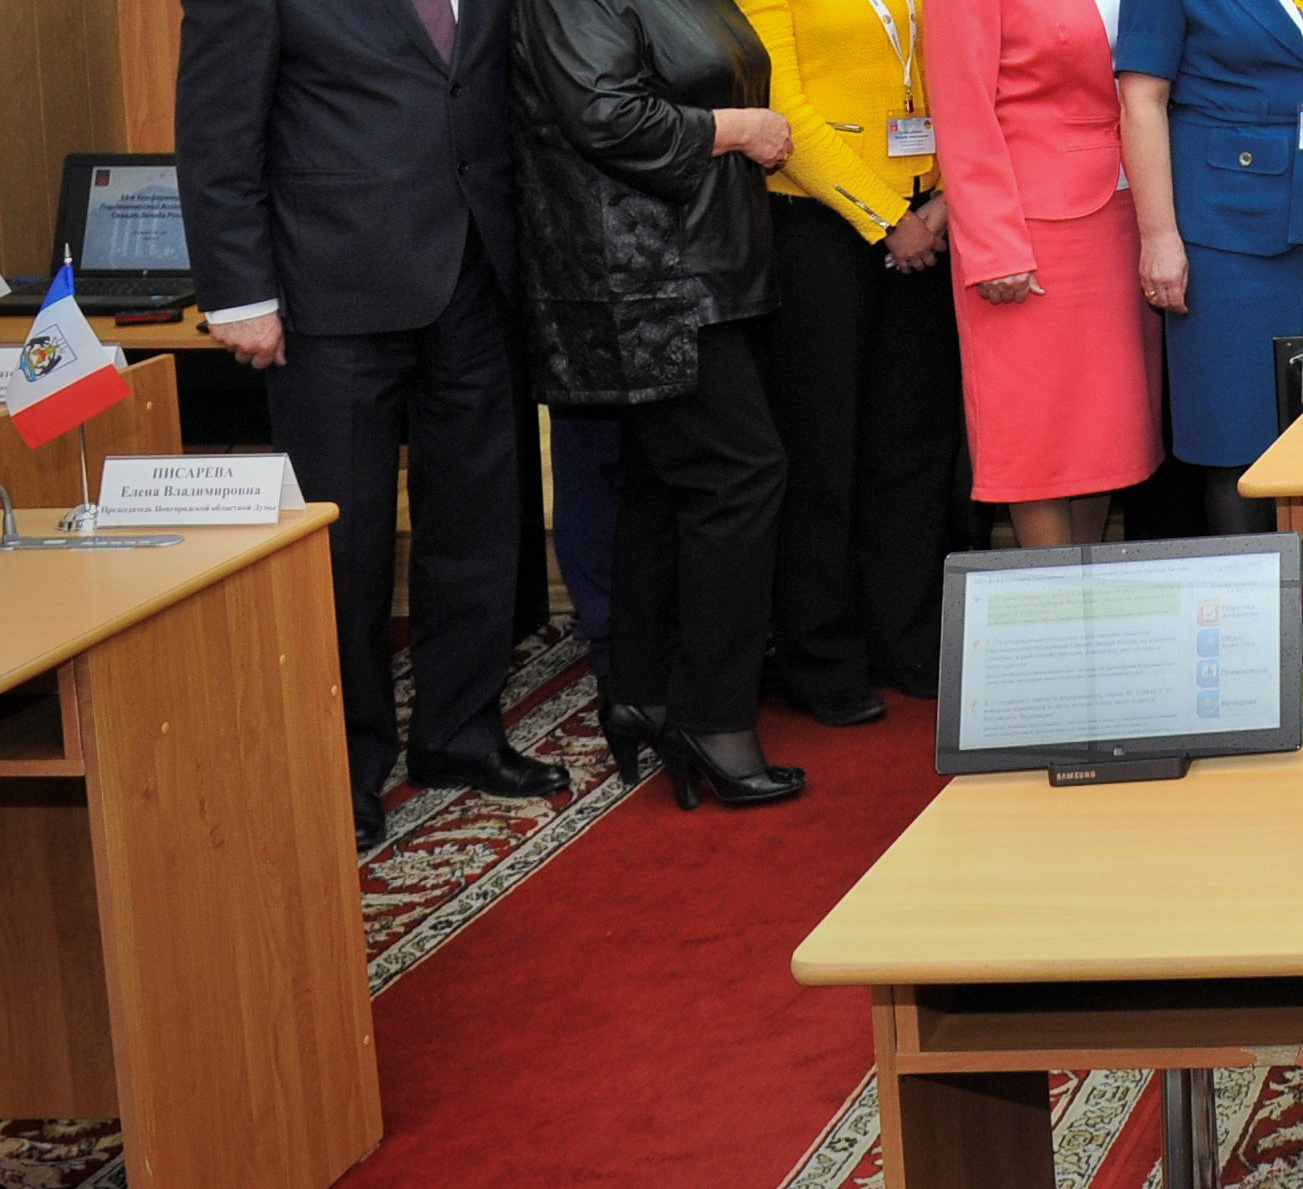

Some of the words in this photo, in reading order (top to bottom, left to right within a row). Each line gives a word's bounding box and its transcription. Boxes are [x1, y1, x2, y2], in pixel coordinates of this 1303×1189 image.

[152, 467, 233, 479] ПИСАРЕВА
[121, 486, 160, 498] Елена
[163, 484, 261, 499] Владимировна
